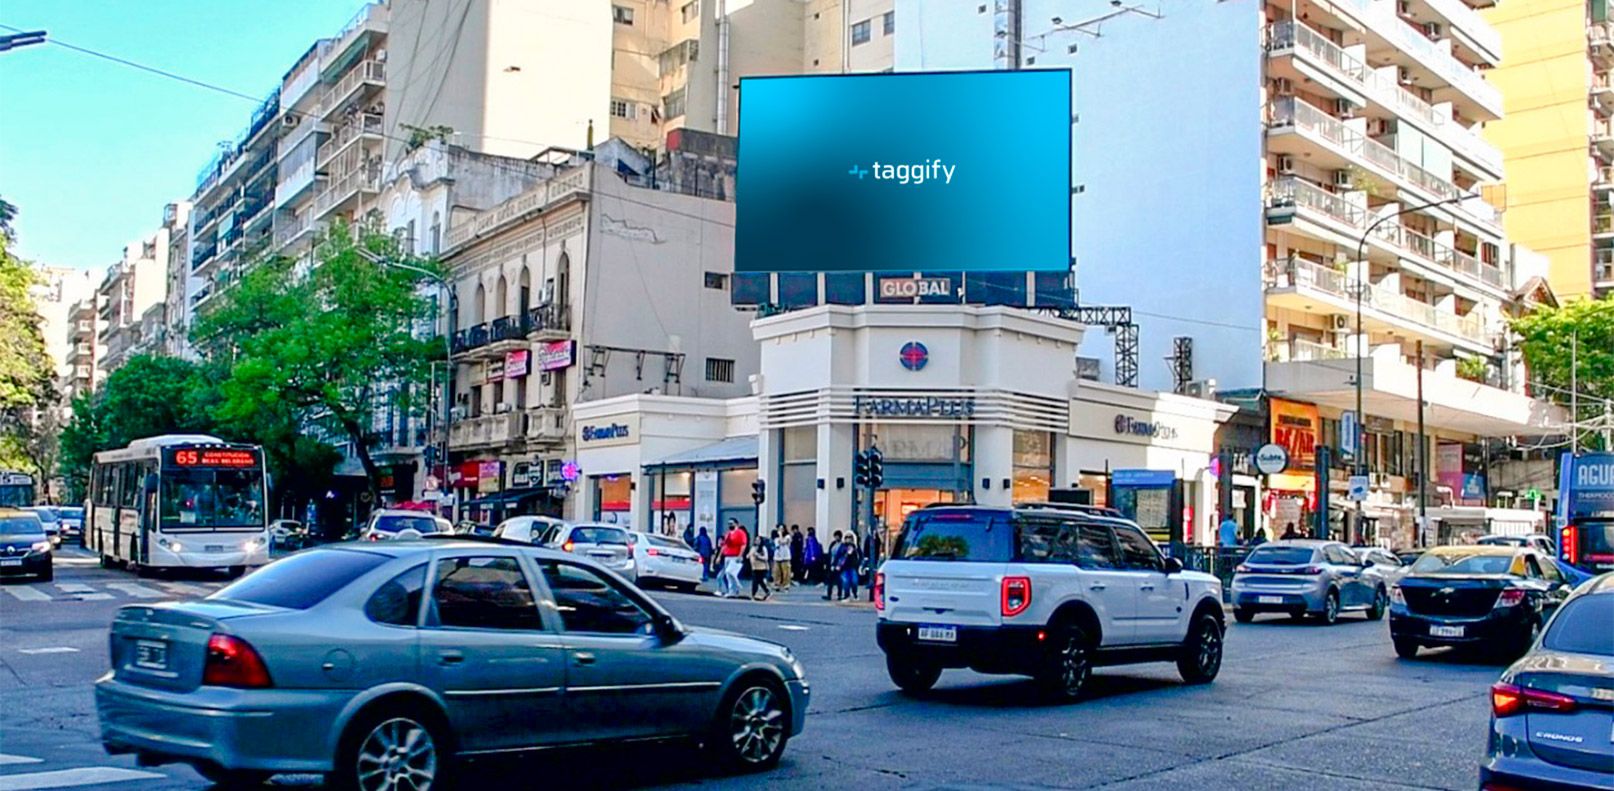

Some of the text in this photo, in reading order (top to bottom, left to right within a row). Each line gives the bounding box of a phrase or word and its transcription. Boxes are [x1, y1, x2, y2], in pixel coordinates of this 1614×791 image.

[872, 159, 956, 184] taggify
[882, 280, 950, 296] GLOBAL
[176, 451, 198, 464] 65
[1536, 731, 1583, 743] CRONOS
